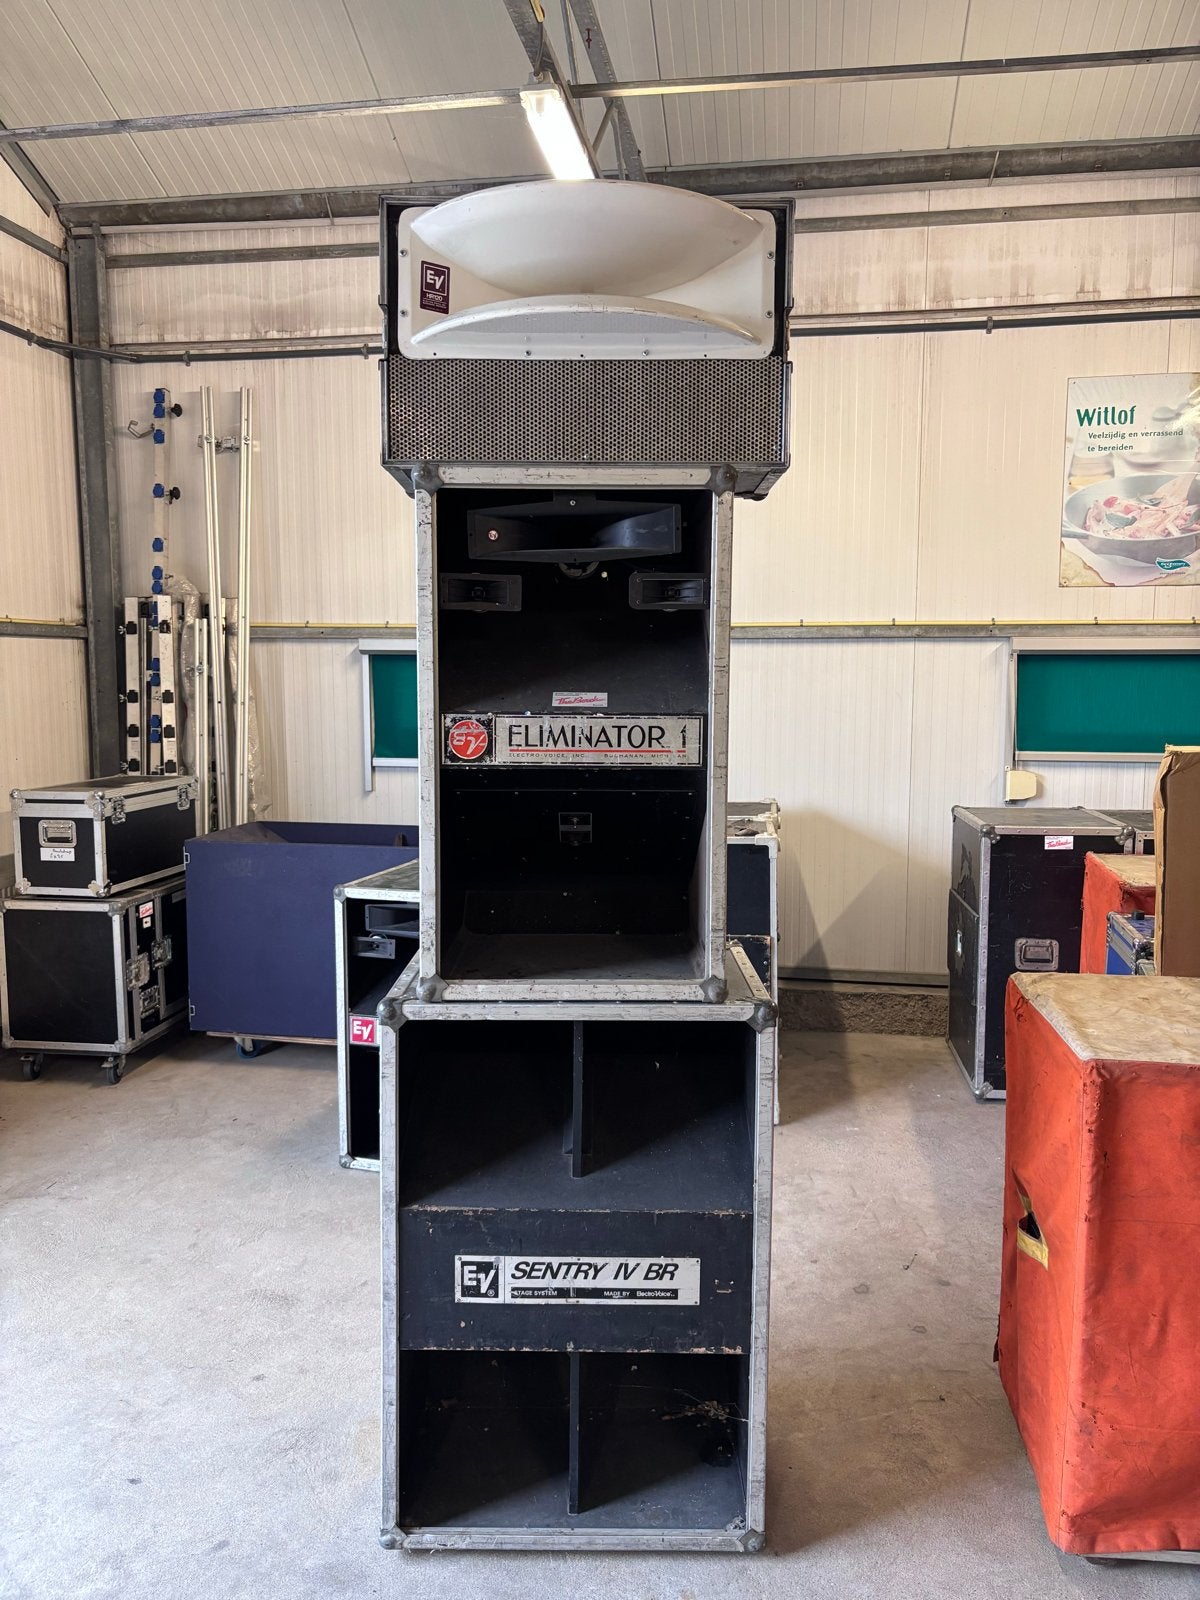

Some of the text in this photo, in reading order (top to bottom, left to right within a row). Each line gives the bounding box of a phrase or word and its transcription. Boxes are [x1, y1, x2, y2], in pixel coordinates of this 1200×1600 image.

[426, 269, 445, 290] EV
[1076, 405, 1136, 427] Witlof
[1088, 431, 1126, 440] Veelzijdig
[1140, 428, 1184, 437] verrassend
[508, 724, 669, 749] ELIMINATOR
[353, 1020, 373, 1041] EV
[463, 1265, 496, 1294] EV
[510, 1261, 679, 1281] SENTRY IV BR
[604, 1290, 620, 1298] MADE
